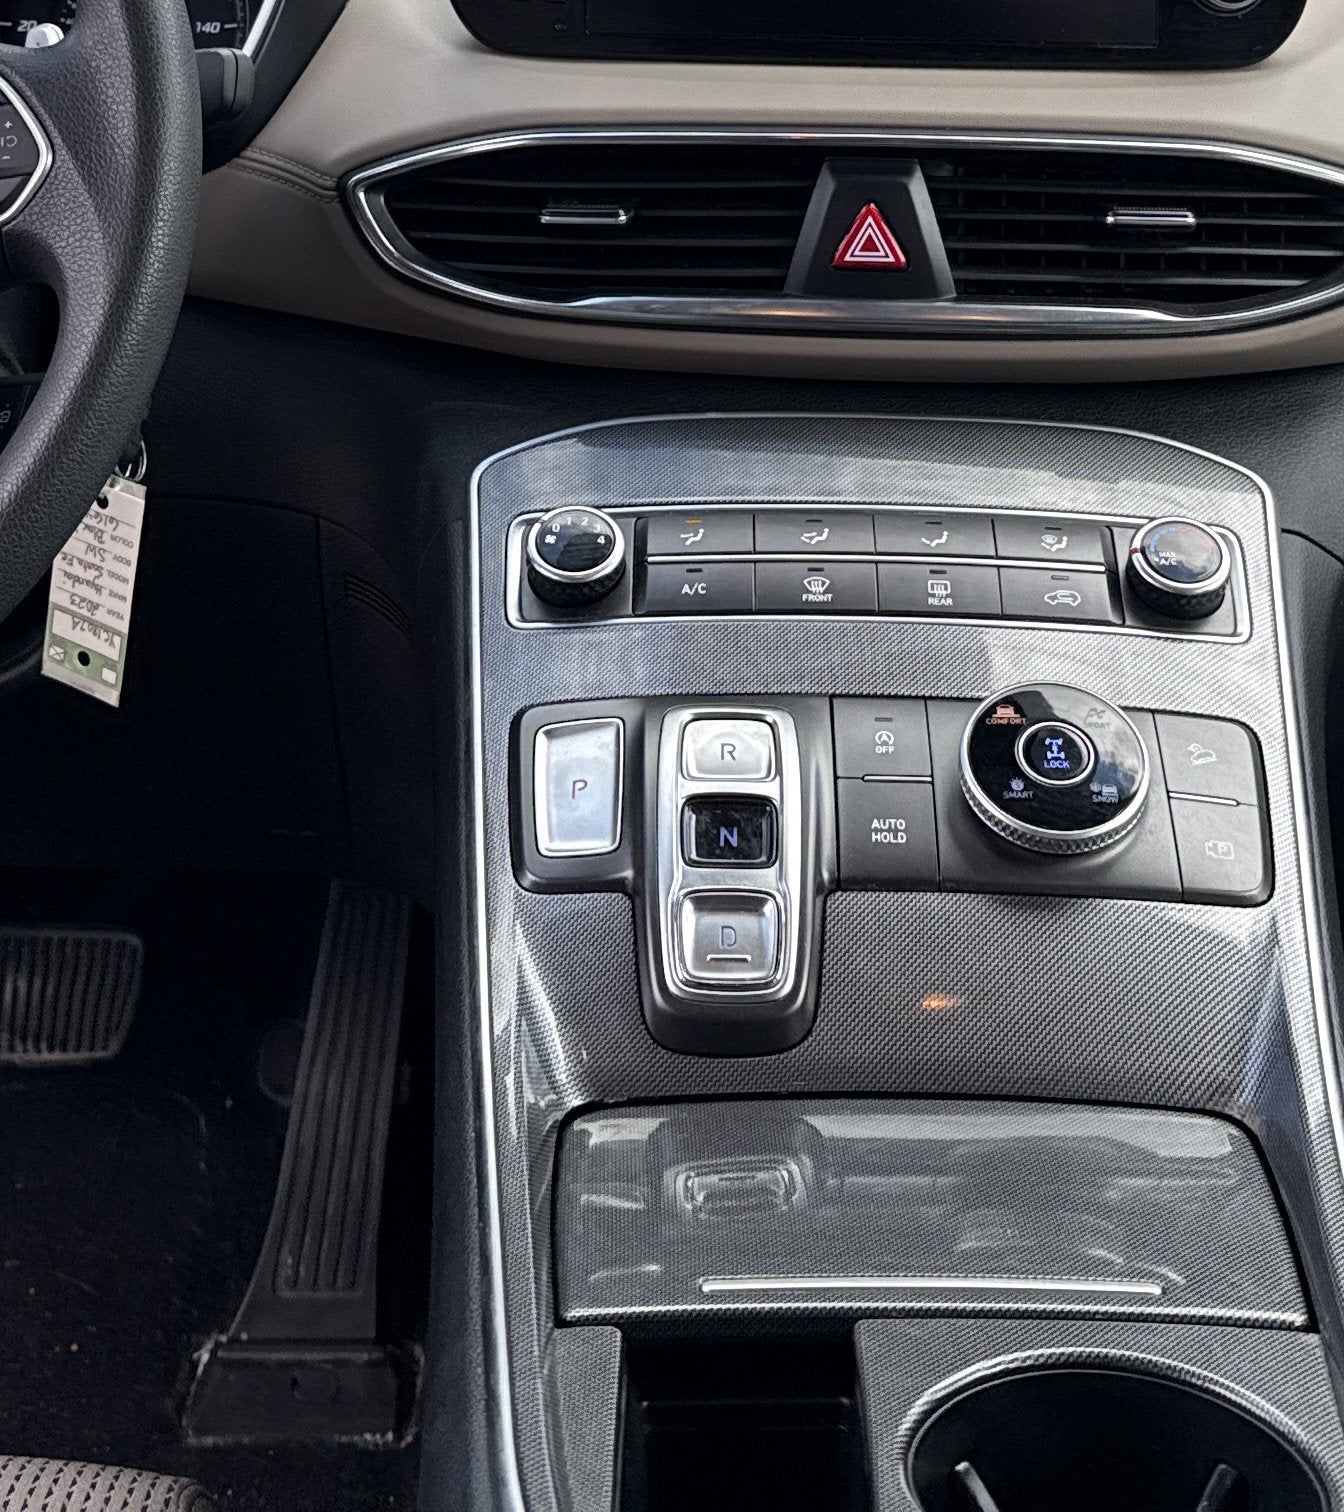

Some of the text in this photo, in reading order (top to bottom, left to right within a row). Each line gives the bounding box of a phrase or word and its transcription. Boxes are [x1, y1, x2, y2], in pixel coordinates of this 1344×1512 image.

[17, 20, 38, 32] 20
[196, 22, 221, 33] 140
[567, 516, 572, 525] 1
[581, 517, 589, 526] 2
[552, 523, 560, 533] 0
[593, 524, 601, 533] 3
[110, 533, 135, 549] COLOR
[596, 535, 606, 544] 4
[112, 554, 132, 567] BODY
[1159, 558, 1177, 566] A/C
[107, 570, 129, 585] MODEL
[682, 582, 706, 595] A/C
[109, 589, 127, 603] MAKE
[802, 593, 832, 603] FRONT
[927, 597, 953, 606] REAR
[70, 595, 124, 620] YEAR 2023
[985, 717, 1026, 725] COMFORT
[721, 743, 737, 762] R
[875, 743, 894, 754] OFF
[1044, 760, 1070, 769] LOCK
[571, 779, 588, 800] P
[1003, 790, 1034, 800] SMART
[1092, 794, 1119, 804] SNOW
[871, 819, 905, 831] AUTO
[720, 828, 737, 846] N
[872, 832, 906, 844] HOLD
[719, 926, 736, 947] D
